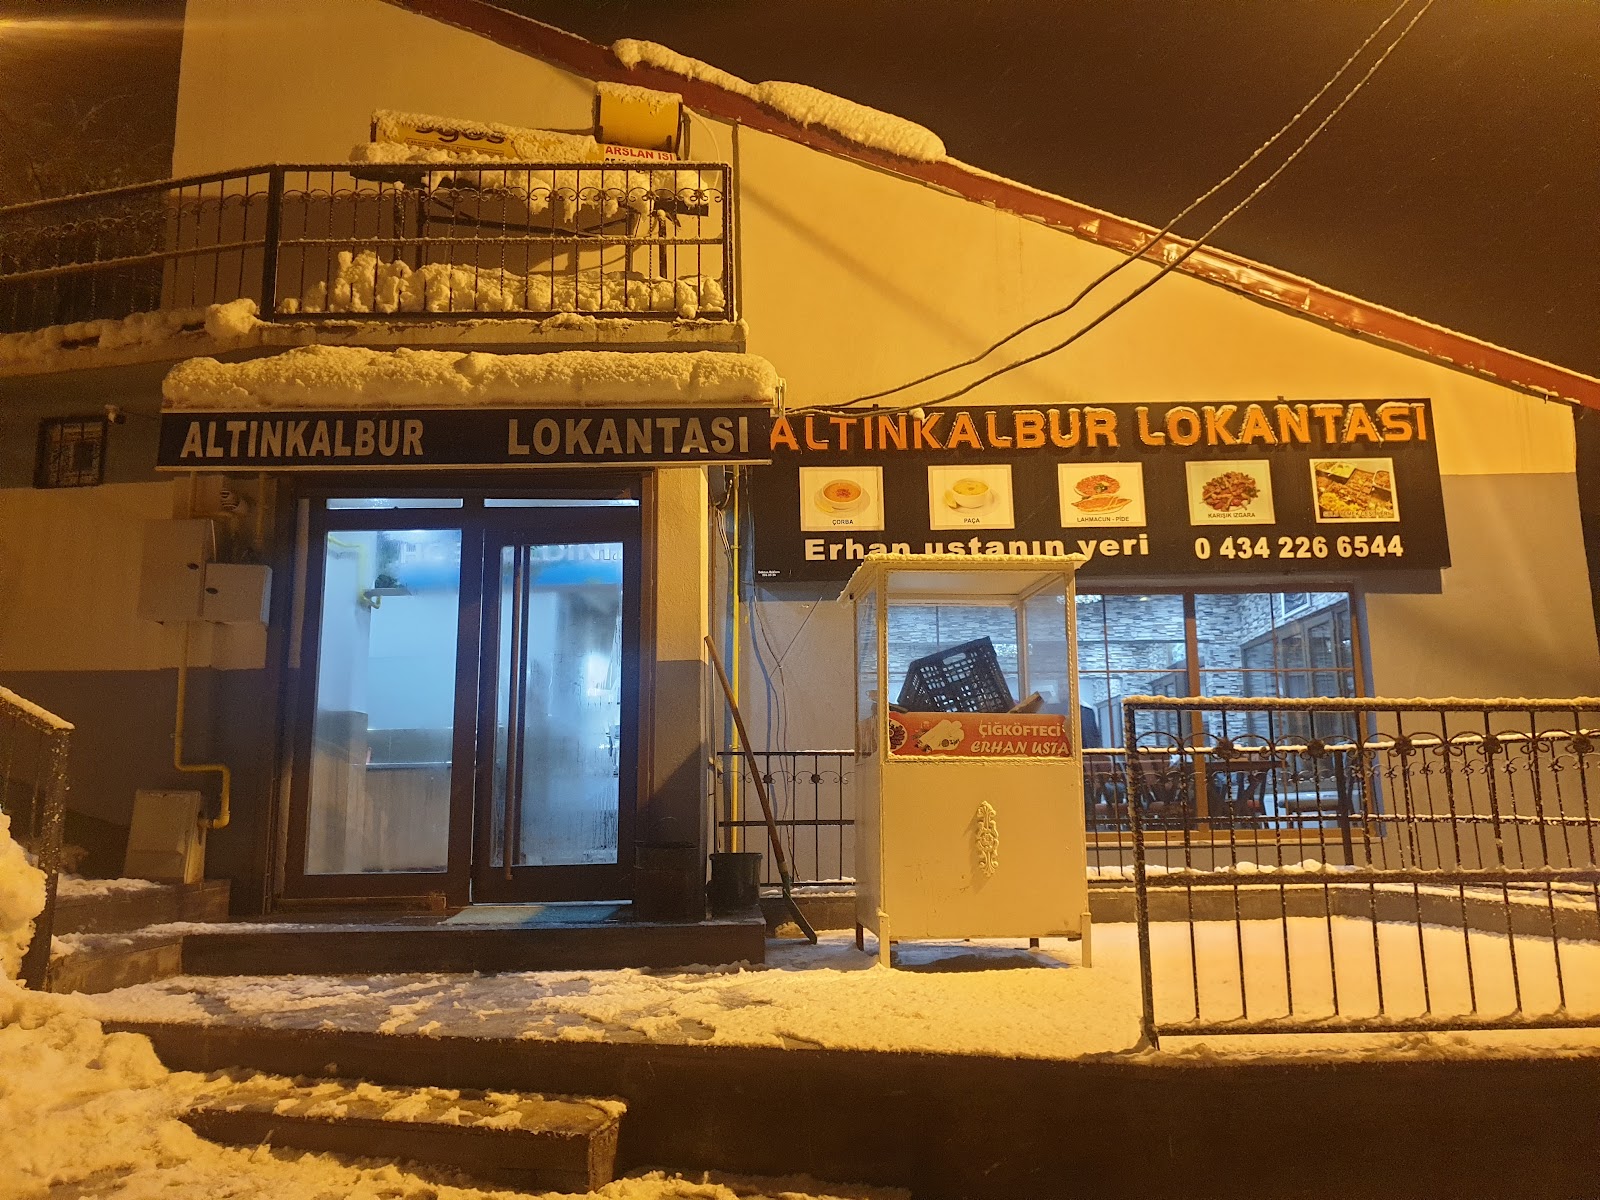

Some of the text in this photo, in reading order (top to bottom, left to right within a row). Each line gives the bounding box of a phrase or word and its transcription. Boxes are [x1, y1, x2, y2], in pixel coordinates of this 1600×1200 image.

[605, 146, 654, 159] ARSLAN
[180, 416, 749, 458] ALTINKALBUR LOKANTASI
[769, 401, 1428, 451] ALTINKALBUR LOKANTASI
[805, 538, 911, 561] Erhan
[1077, 533, 1149, 561] yeri
[1194, 534, 1404, 560] 0 434 226 6544
[979, 722, 1063, 738] ÇİĞKÖFTECİ
[970, 740, 1069, 754] ERHAN USTA
